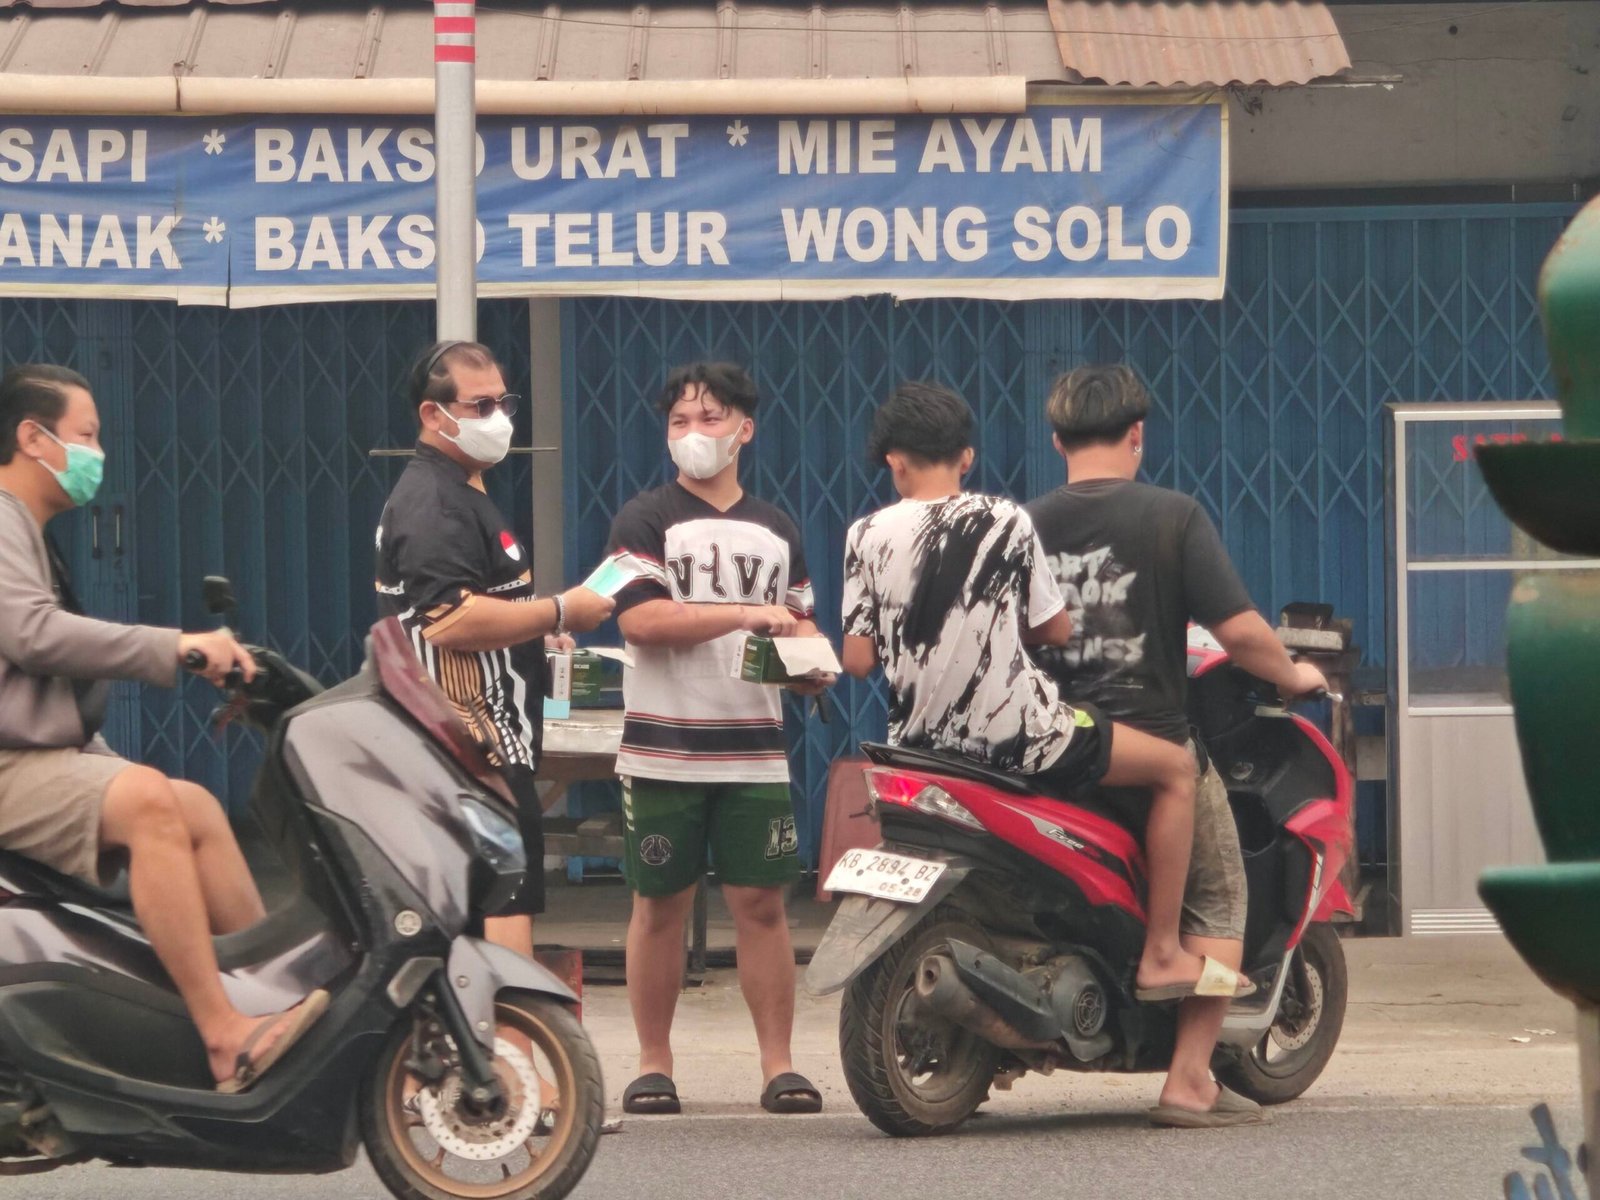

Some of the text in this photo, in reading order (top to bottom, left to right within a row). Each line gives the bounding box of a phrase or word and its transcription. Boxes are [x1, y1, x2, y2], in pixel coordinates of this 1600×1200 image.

[0, 118, 1102, 183] SAPI BAKS URAT MIE AYAM
[0, 204, 1192, 270] ANAK BAKS TELUR WONG SOLO
[838, 853, 862, 869] KB
[914, 865, 940, 882] BZ
